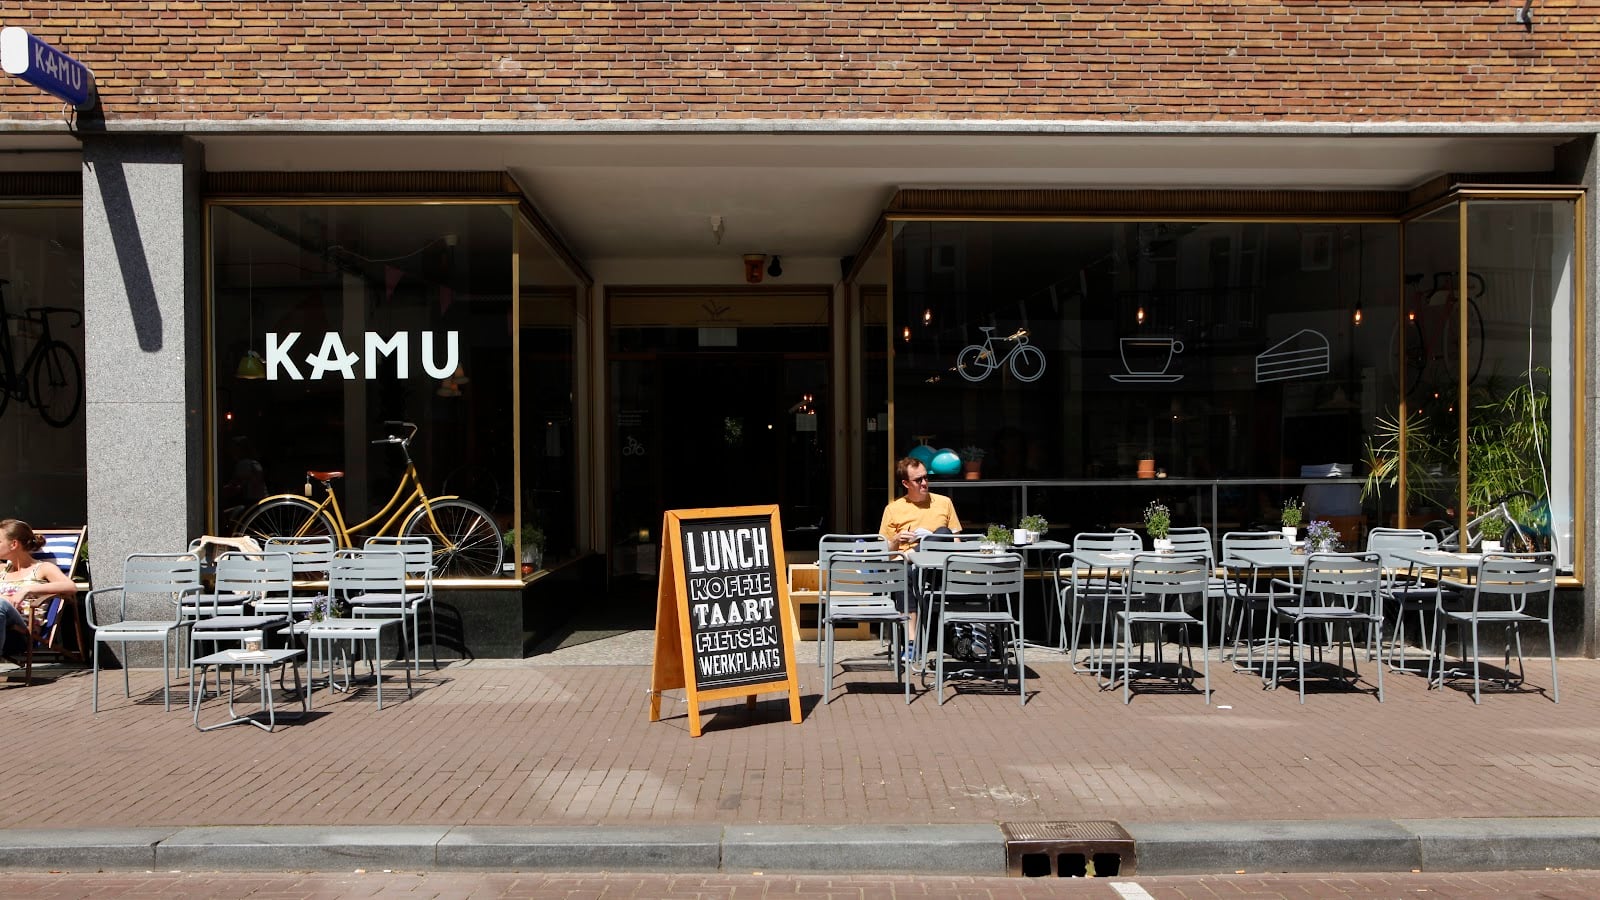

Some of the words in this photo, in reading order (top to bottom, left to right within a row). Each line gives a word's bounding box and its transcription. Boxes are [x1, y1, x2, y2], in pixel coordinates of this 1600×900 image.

[35, 42, 81, 90] KAMU
[266, 330, 459, 381] KAMU
[685, 527, 770, 573] LUNCH
[690, 573, 772, 600] KOFFIE
[693, 597, 774, 628] TAART
[696, 626, 778, 653] FIETSEN
[699, 648, 780, 677] WERKPLAATS
